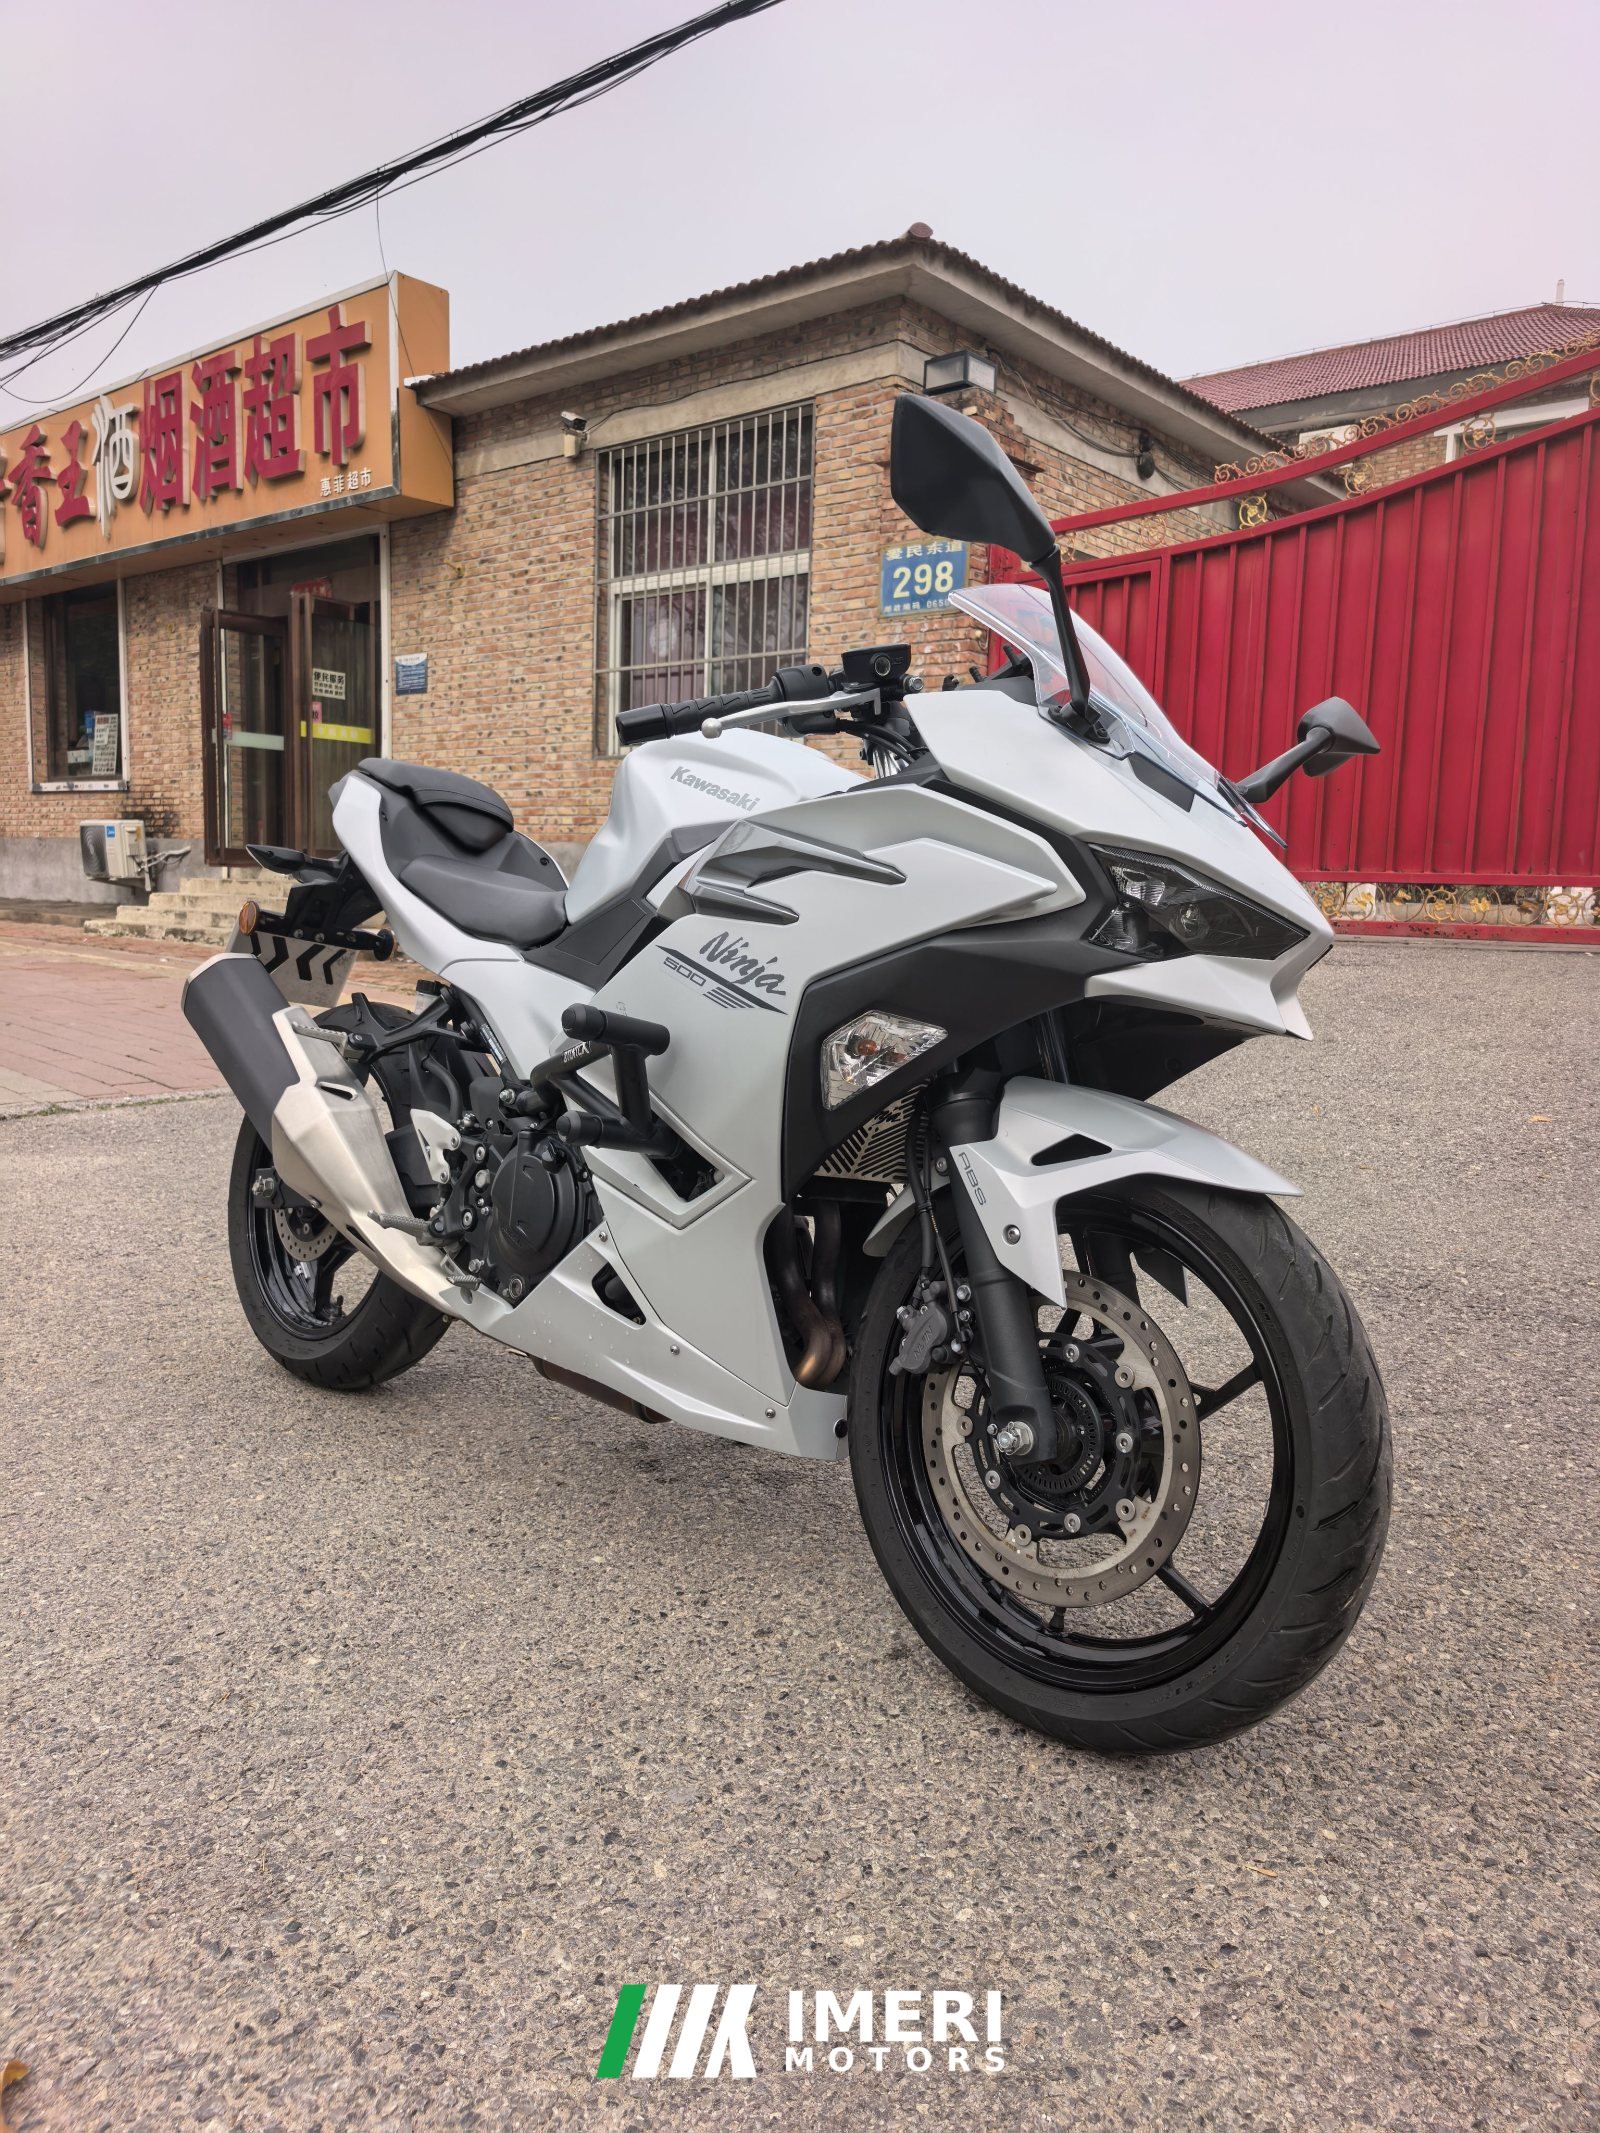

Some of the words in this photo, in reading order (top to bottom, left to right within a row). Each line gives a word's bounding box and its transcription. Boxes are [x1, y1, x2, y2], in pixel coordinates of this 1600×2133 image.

[893, 561, 954, 599] 298
[926, 599, 950, 609] 0650
[670, 766, 760, 812] Kawasaki
[663, 956, 706, 987] 500
[699, 931, 786, 996] Ninja
[958, 1151, 987, 1206] ABS
